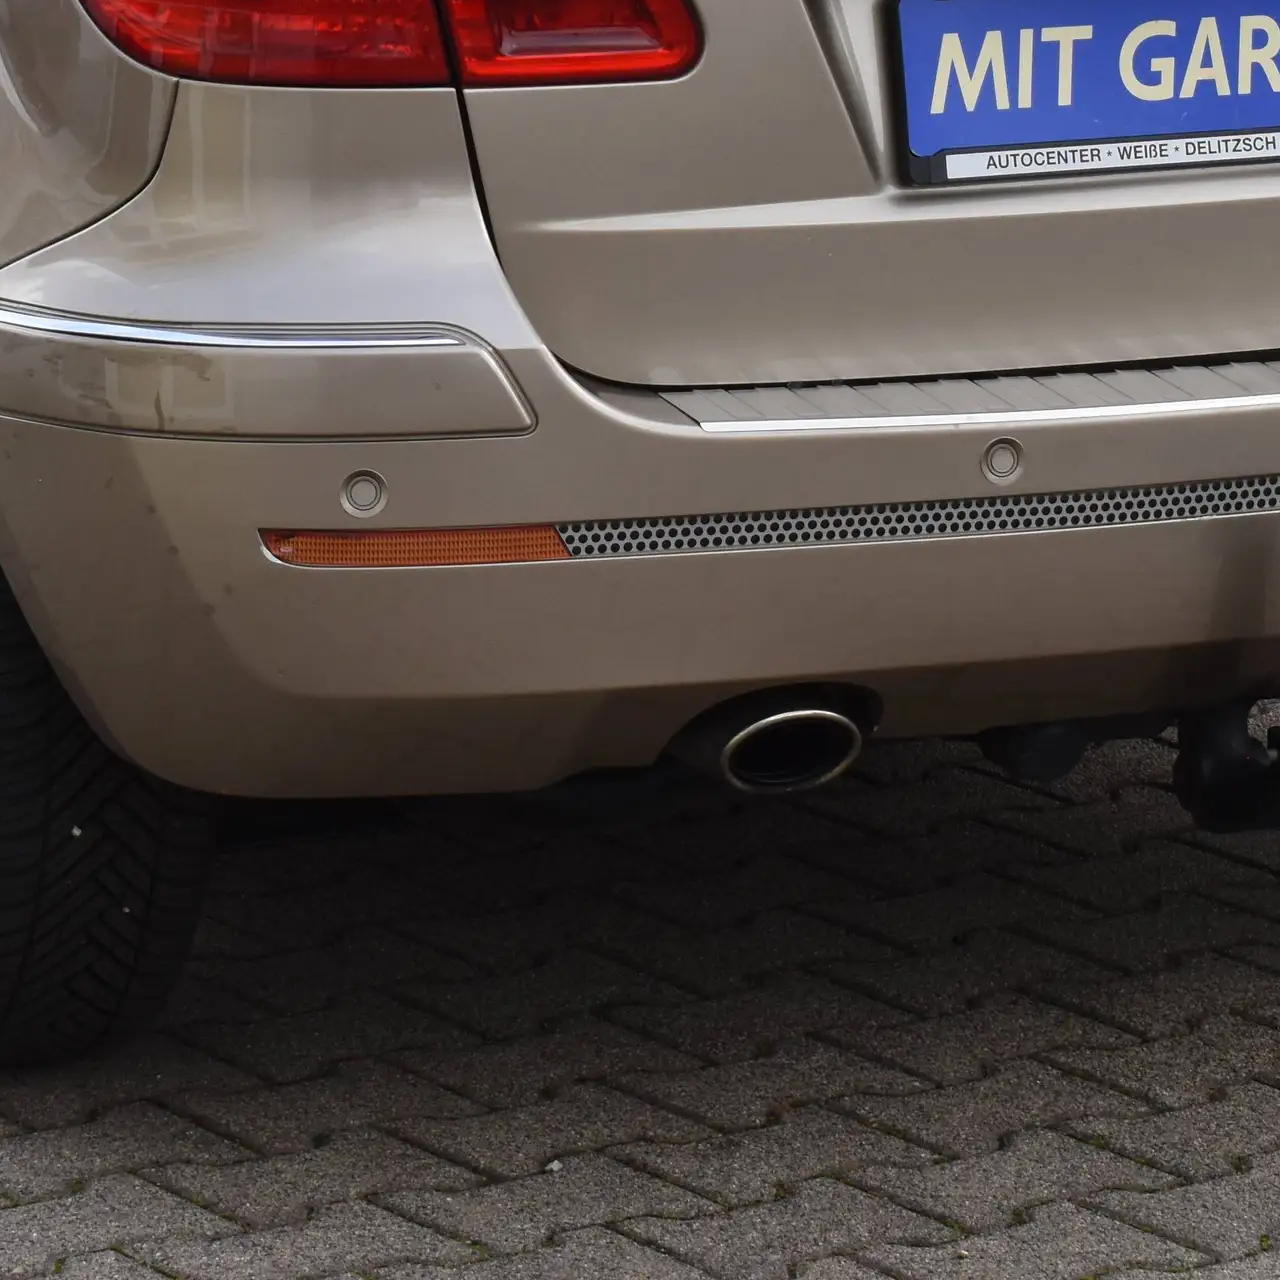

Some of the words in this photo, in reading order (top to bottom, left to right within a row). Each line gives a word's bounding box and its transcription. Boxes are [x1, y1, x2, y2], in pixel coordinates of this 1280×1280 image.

[931, 25, 1094, 114] MIT
[986, 147, 1102, 170] AUTOCENTER
[1185, 136, 1277, 156] DELITZSCH
